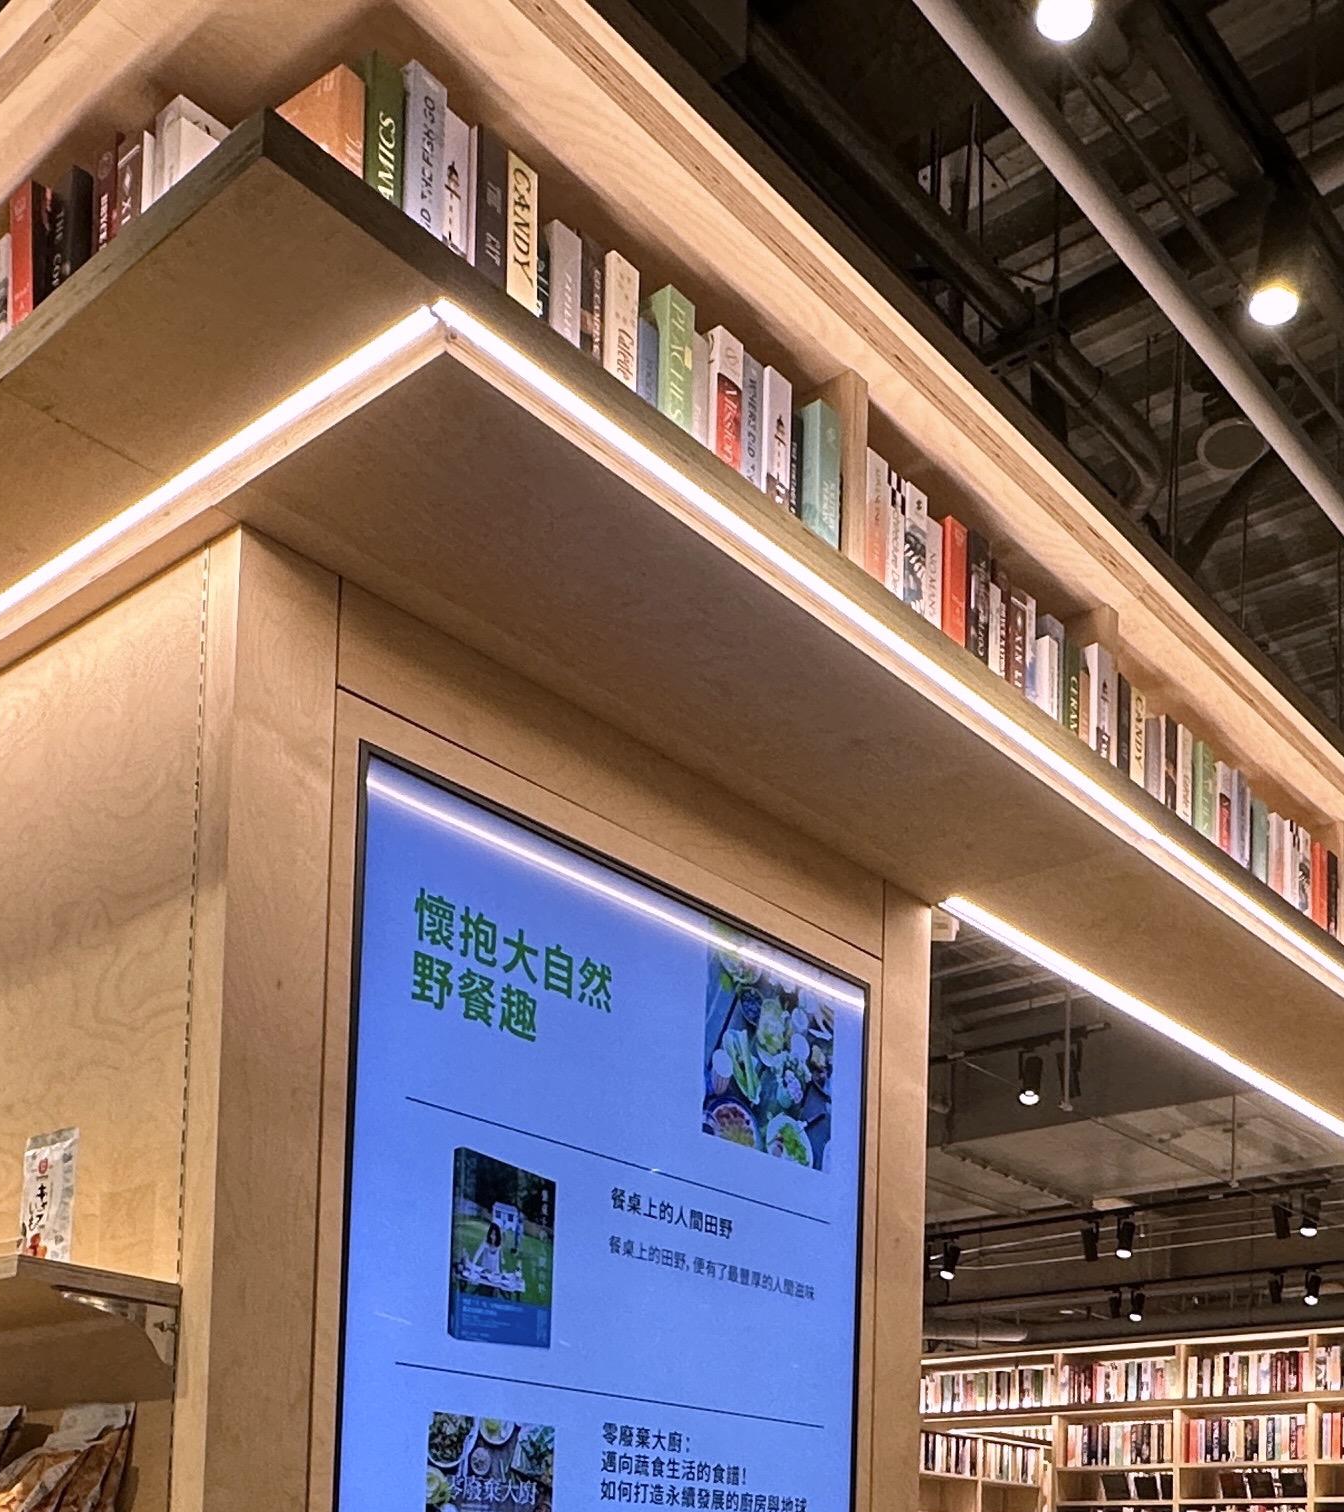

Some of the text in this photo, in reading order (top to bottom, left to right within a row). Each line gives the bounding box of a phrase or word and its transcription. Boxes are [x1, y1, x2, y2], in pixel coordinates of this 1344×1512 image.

[512, 167, 534, 288] CANDY
[410, 949, 538, 1042] 野餐趣
[412, 887, 613, 1013] 懷抱大自然
[611, 1187, 733, 1240] 餐桌上的人間田野
